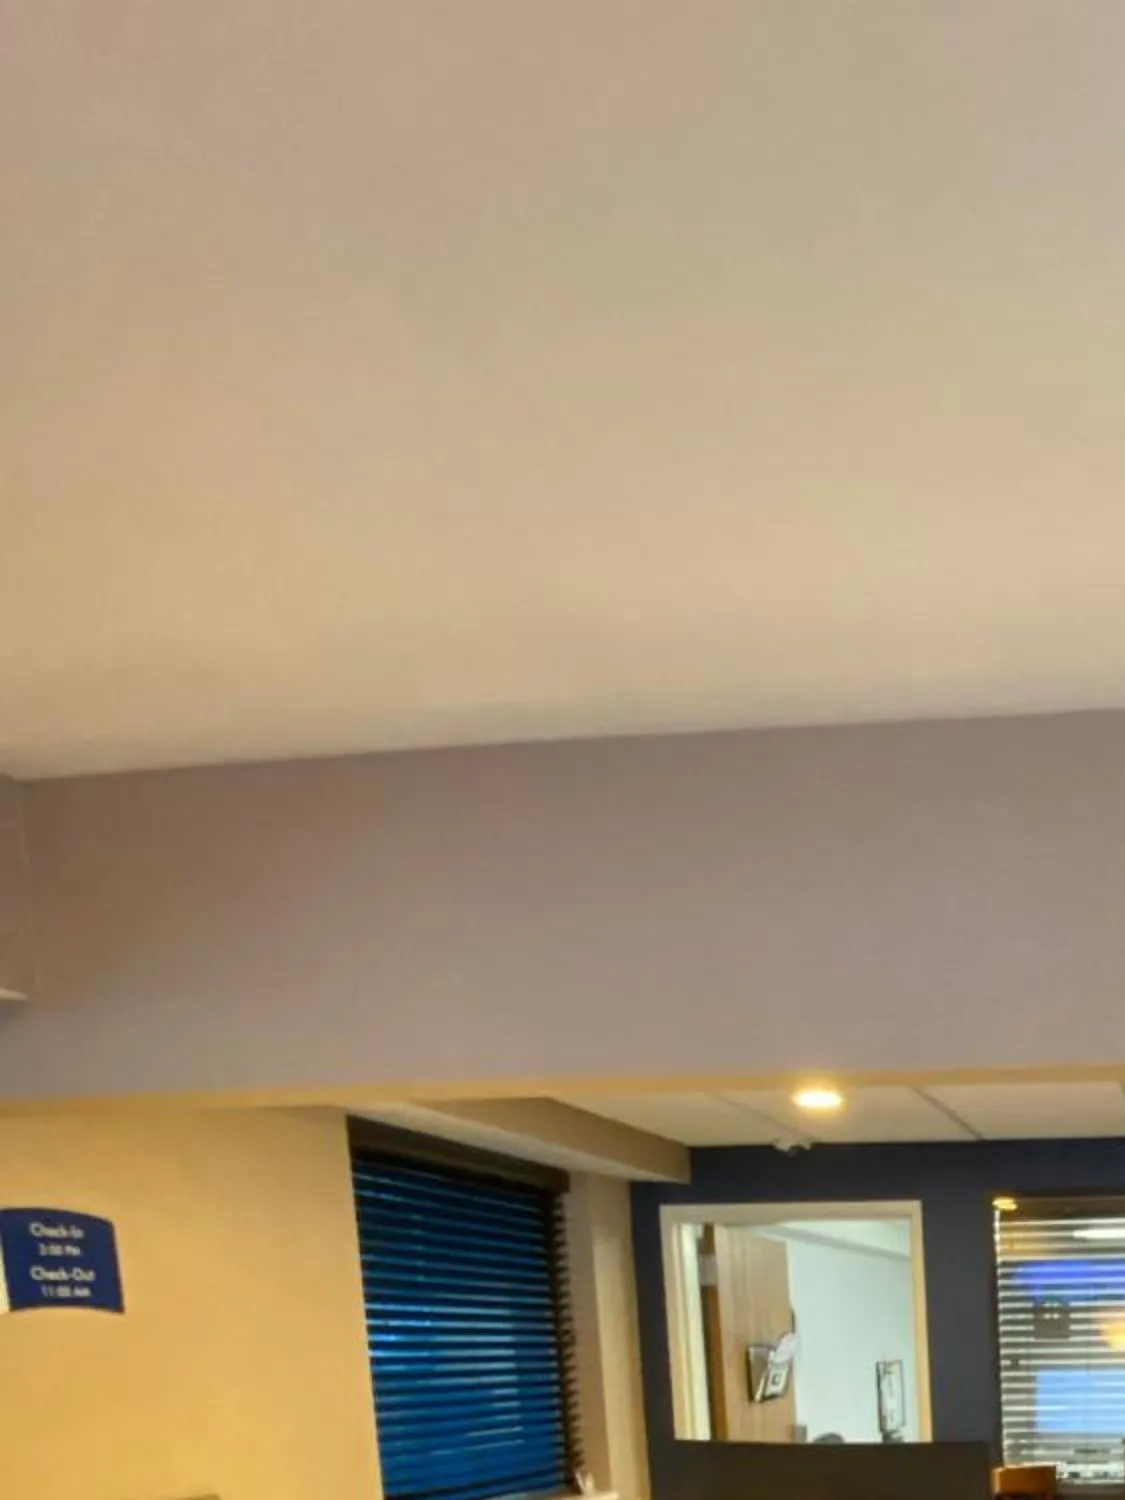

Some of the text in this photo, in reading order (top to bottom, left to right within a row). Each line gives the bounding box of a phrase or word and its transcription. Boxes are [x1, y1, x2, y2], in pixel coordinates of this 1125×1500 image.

[29, 1222, 84, 1238] Check-In
[30, 1266, 95, 1281] Check-Out
[42, 1286, 70, 1297] 11:00
